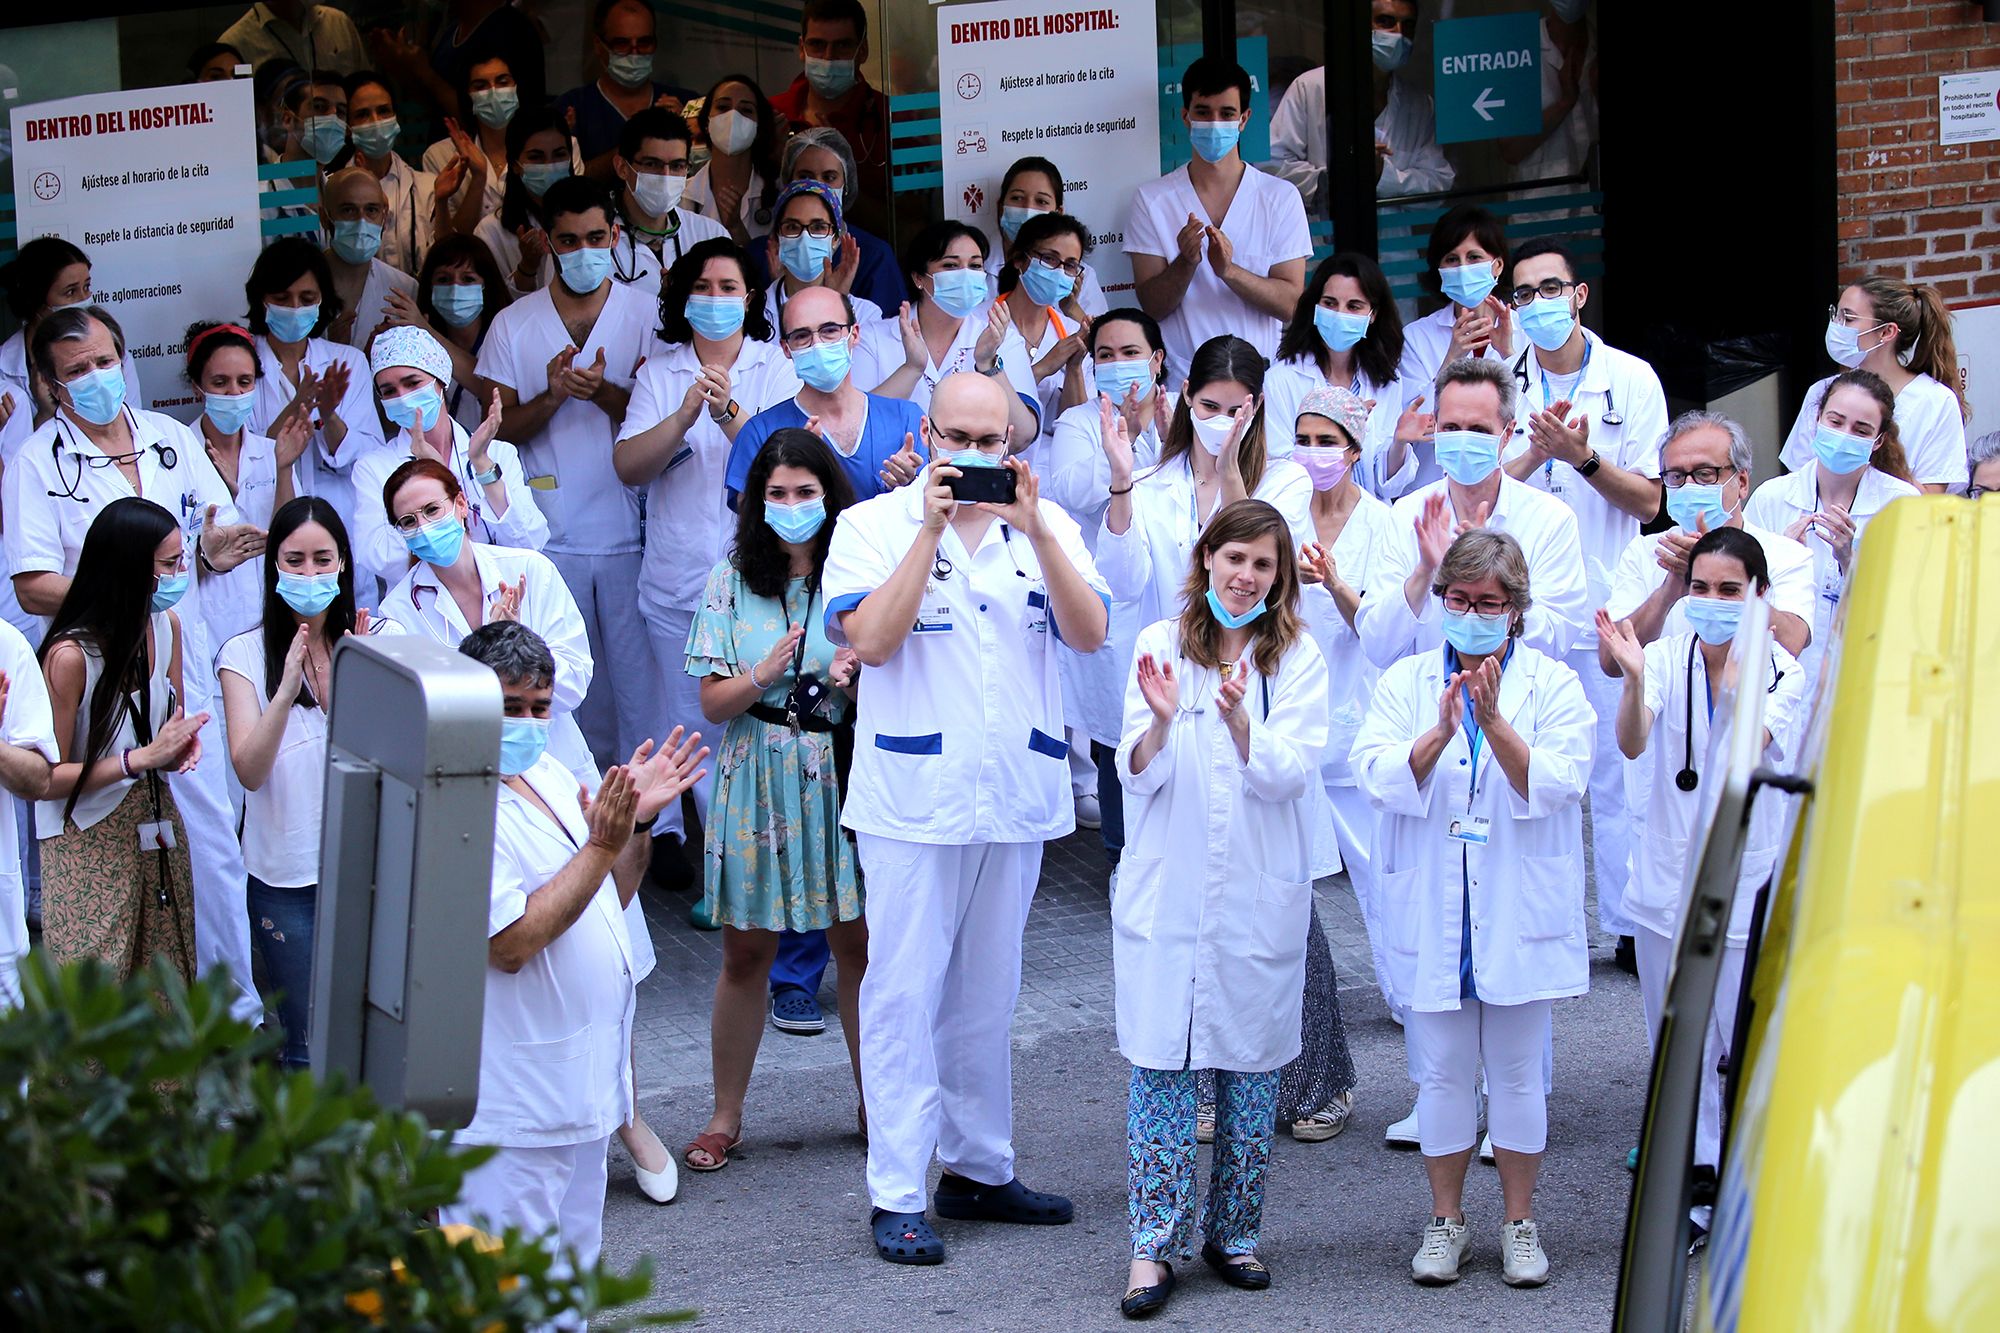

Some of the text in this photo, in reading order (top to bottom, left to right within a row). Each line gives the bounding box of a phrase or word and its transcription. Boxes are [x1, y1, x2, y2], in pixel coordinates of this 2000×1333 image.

[951, 9, 1119, 44] DENTRO DEL HOSPITAL:
[1442, 49, 1533, 75] ENTRADA
[1000, 67, 1115, 92] Ajústese al horario de la cita
[1944, 93, 1973, 101] Prohibido
[1973, 101, 1994, 109] recinto
[26, 102, 214, 142] DENTRO DEL HOSPITAL:
[1950, 112, 1986, 121] hospitalario
[1001, 116, 1136, 143] Respete la distancia de seguridad
[81, 163, 209, 192] Ajústese al horario de la cita
[84, 216, 234, 246] Respete la distancia de seguridad
[1099, 232, 1117, 245] solo
[1118, 233, 1124, 243] a
[92, 283, 182, 304] vite aglomeraciones
[152, 397, 180, 409] Gracias
[181, 397, 193, 406] por
